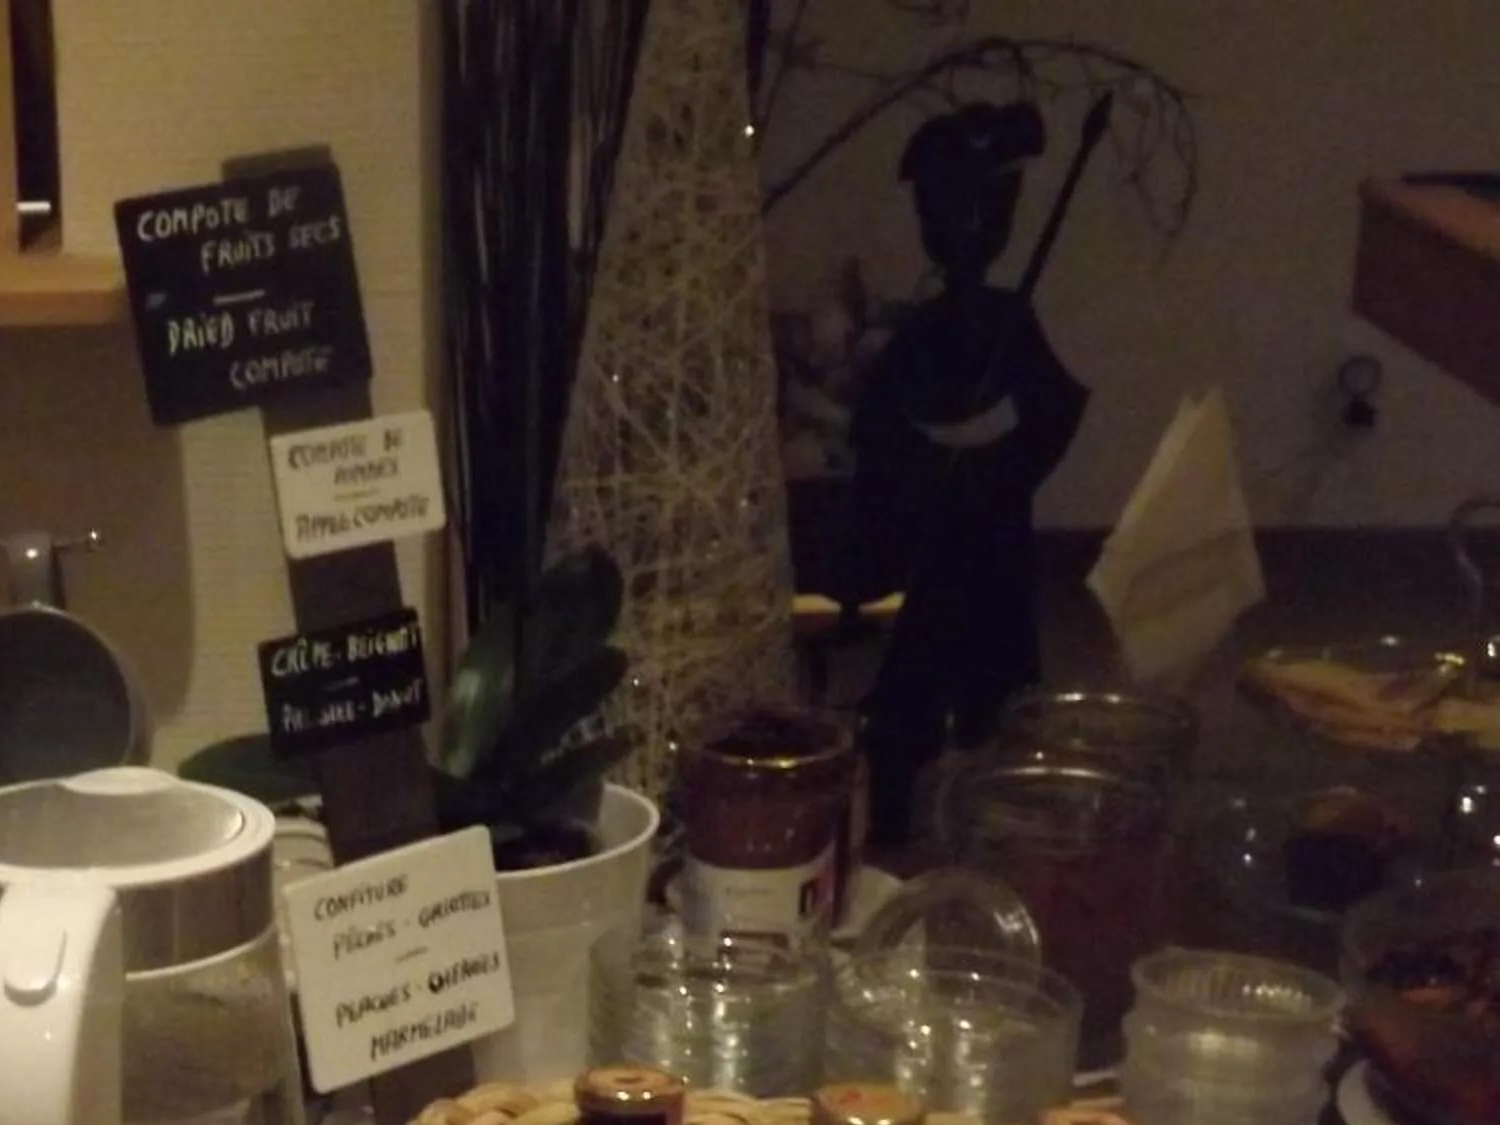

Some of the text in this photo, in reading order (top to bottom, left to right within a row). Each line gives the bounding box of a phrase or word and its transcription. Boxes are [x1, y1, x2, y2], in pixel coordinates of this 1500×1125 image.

[137, 184, 301, 242] COMPOTE DE
[288, 215, 341, 250] SECS
[228, 346, 333, 391] COMPOTE
[314, 873, 408, 922] CONFITURE
